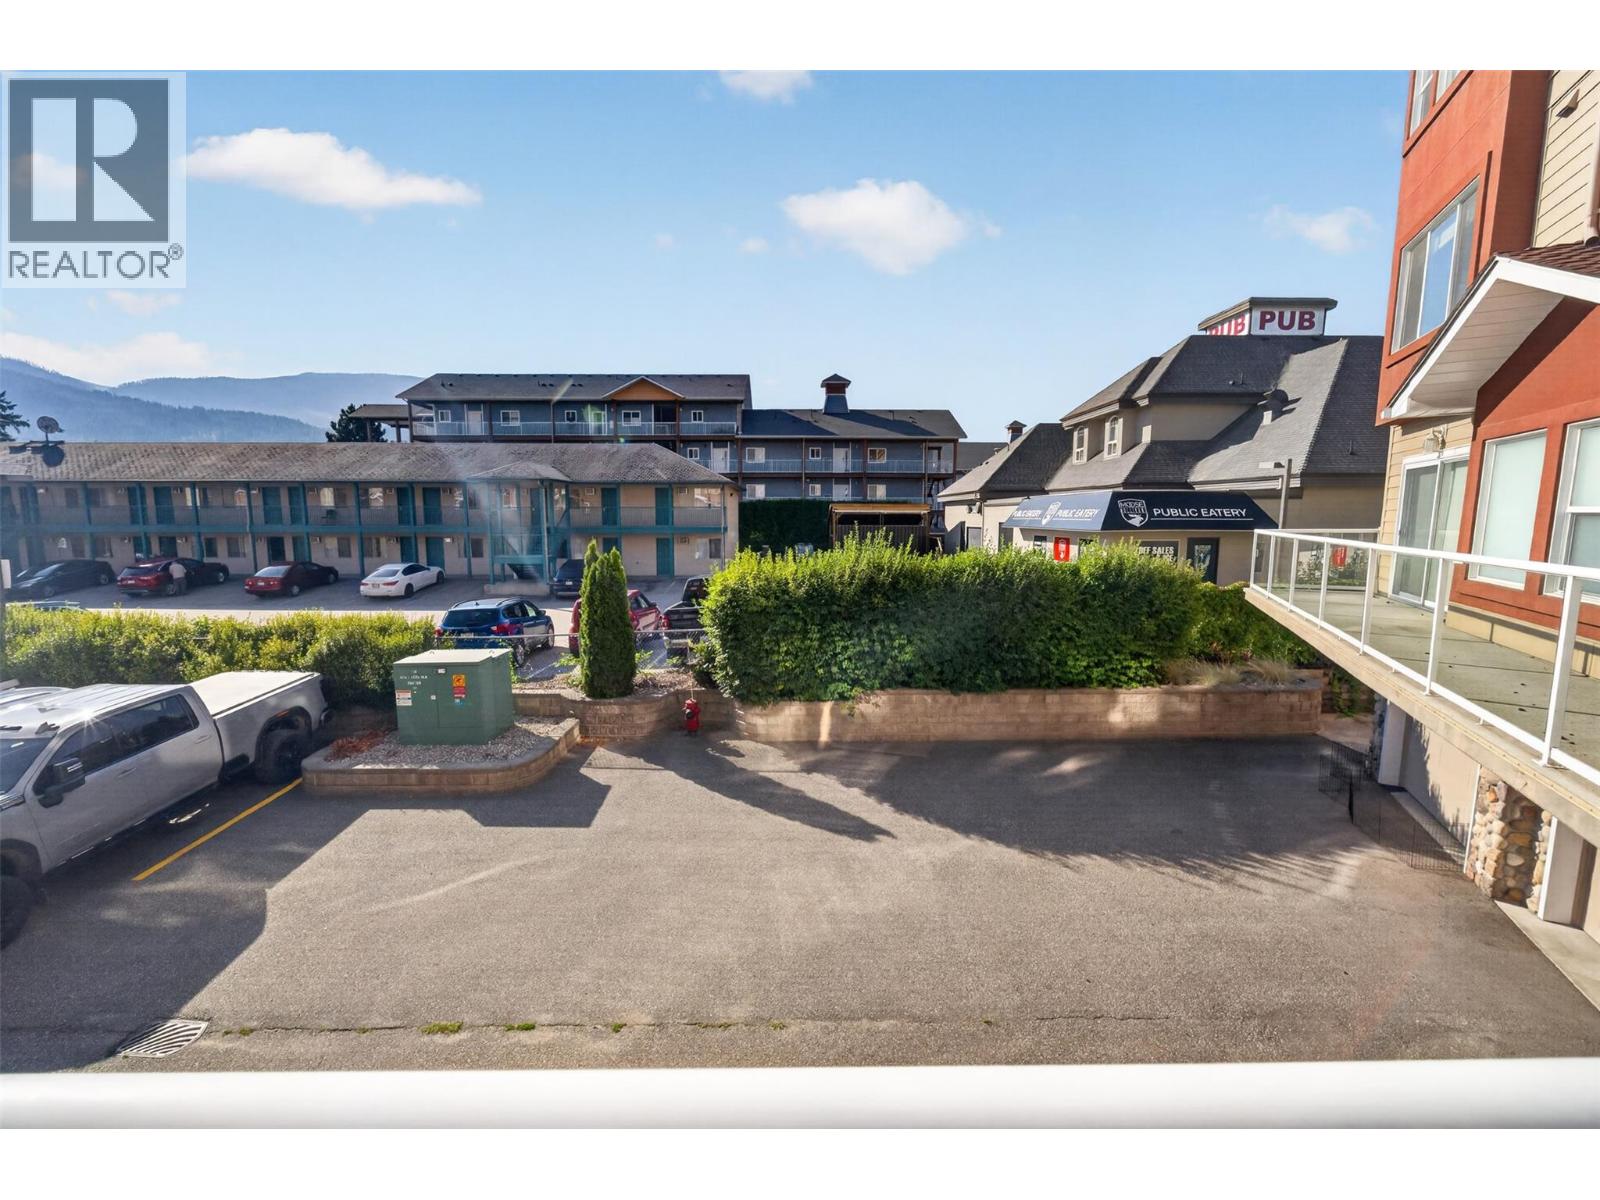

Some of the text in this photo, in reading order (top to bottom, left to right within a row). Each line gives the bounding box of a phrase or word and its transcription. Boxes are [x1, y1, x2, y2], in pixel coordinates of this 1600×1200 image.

[1259, 310, 1316, 331] PUB
[1153, 508, 1199, 517] PUBLIC
[1201, 508, 1247, 517] EATERY
[1152, 546, 1175, 555] SALES
